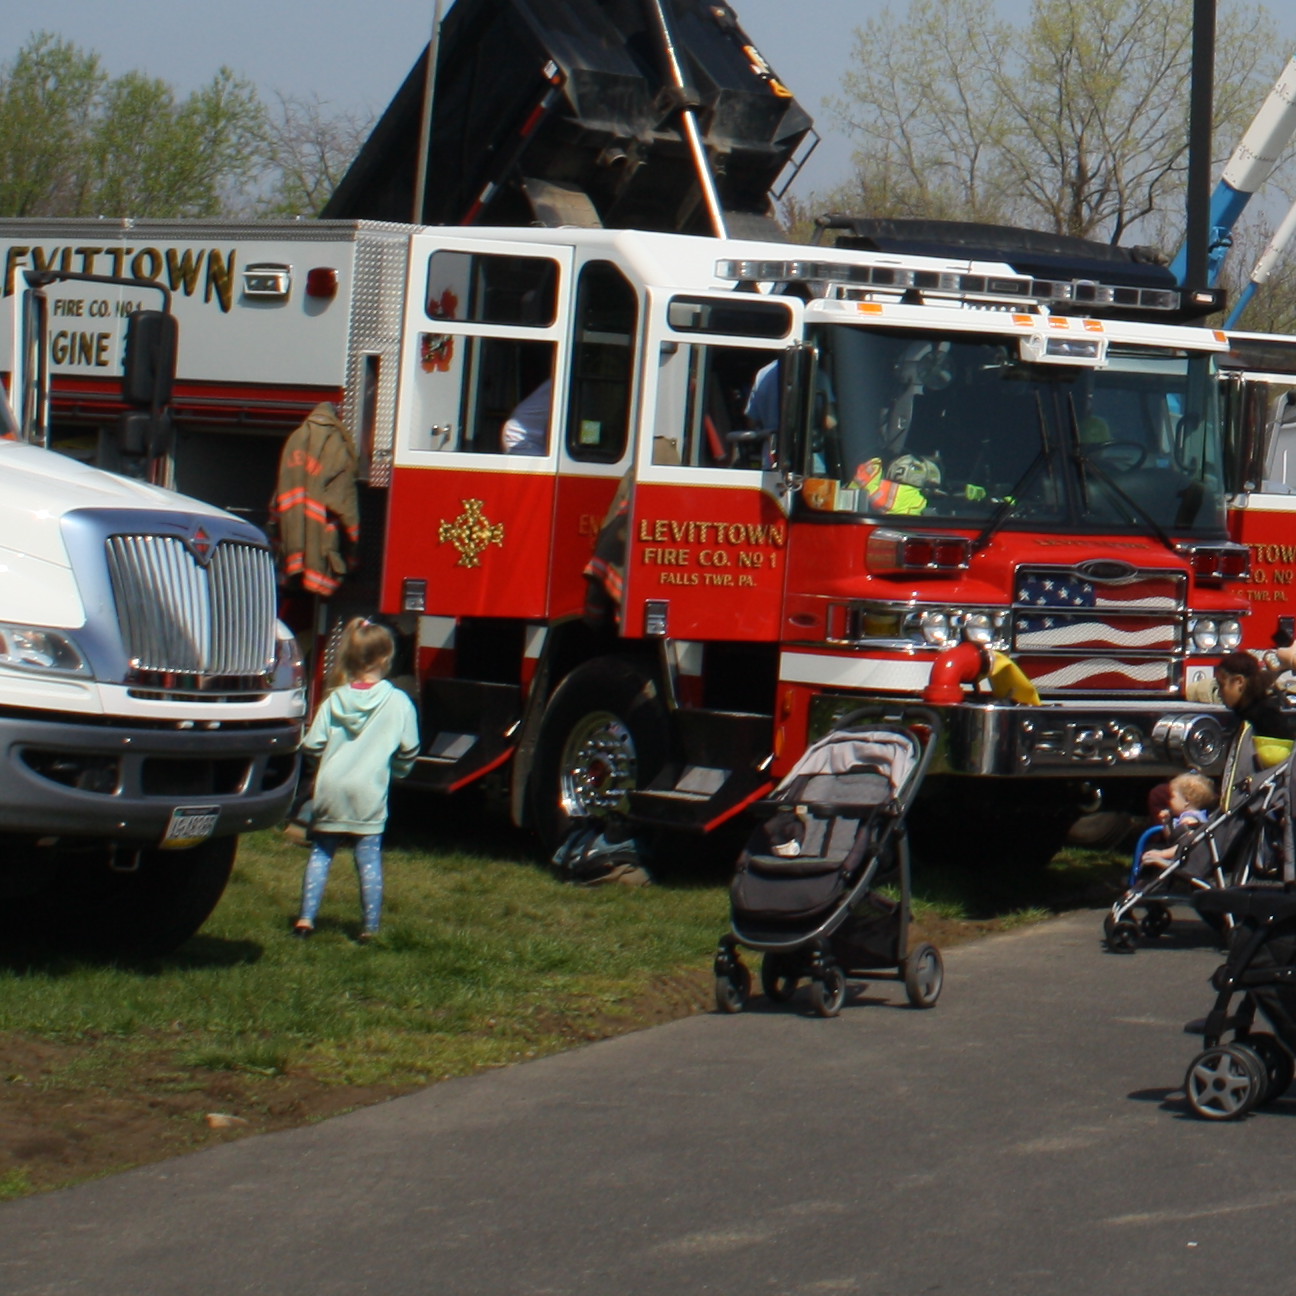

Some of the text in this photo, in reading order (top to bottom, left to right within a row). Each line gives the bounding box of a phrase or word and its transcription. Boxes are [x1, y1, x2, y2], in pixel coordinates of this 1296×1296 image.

[53, 299, 84, 316] FIRE
[89, 300, 111, 317] CO.
[639, 519, 786, 547] LEVITTOWN
[644, 548, 690, 565] FIRE
[699, 550, 731, 567] CO.
[660, 572, 698, 585] FALLS
[739, 575, 757, 587] PA.
